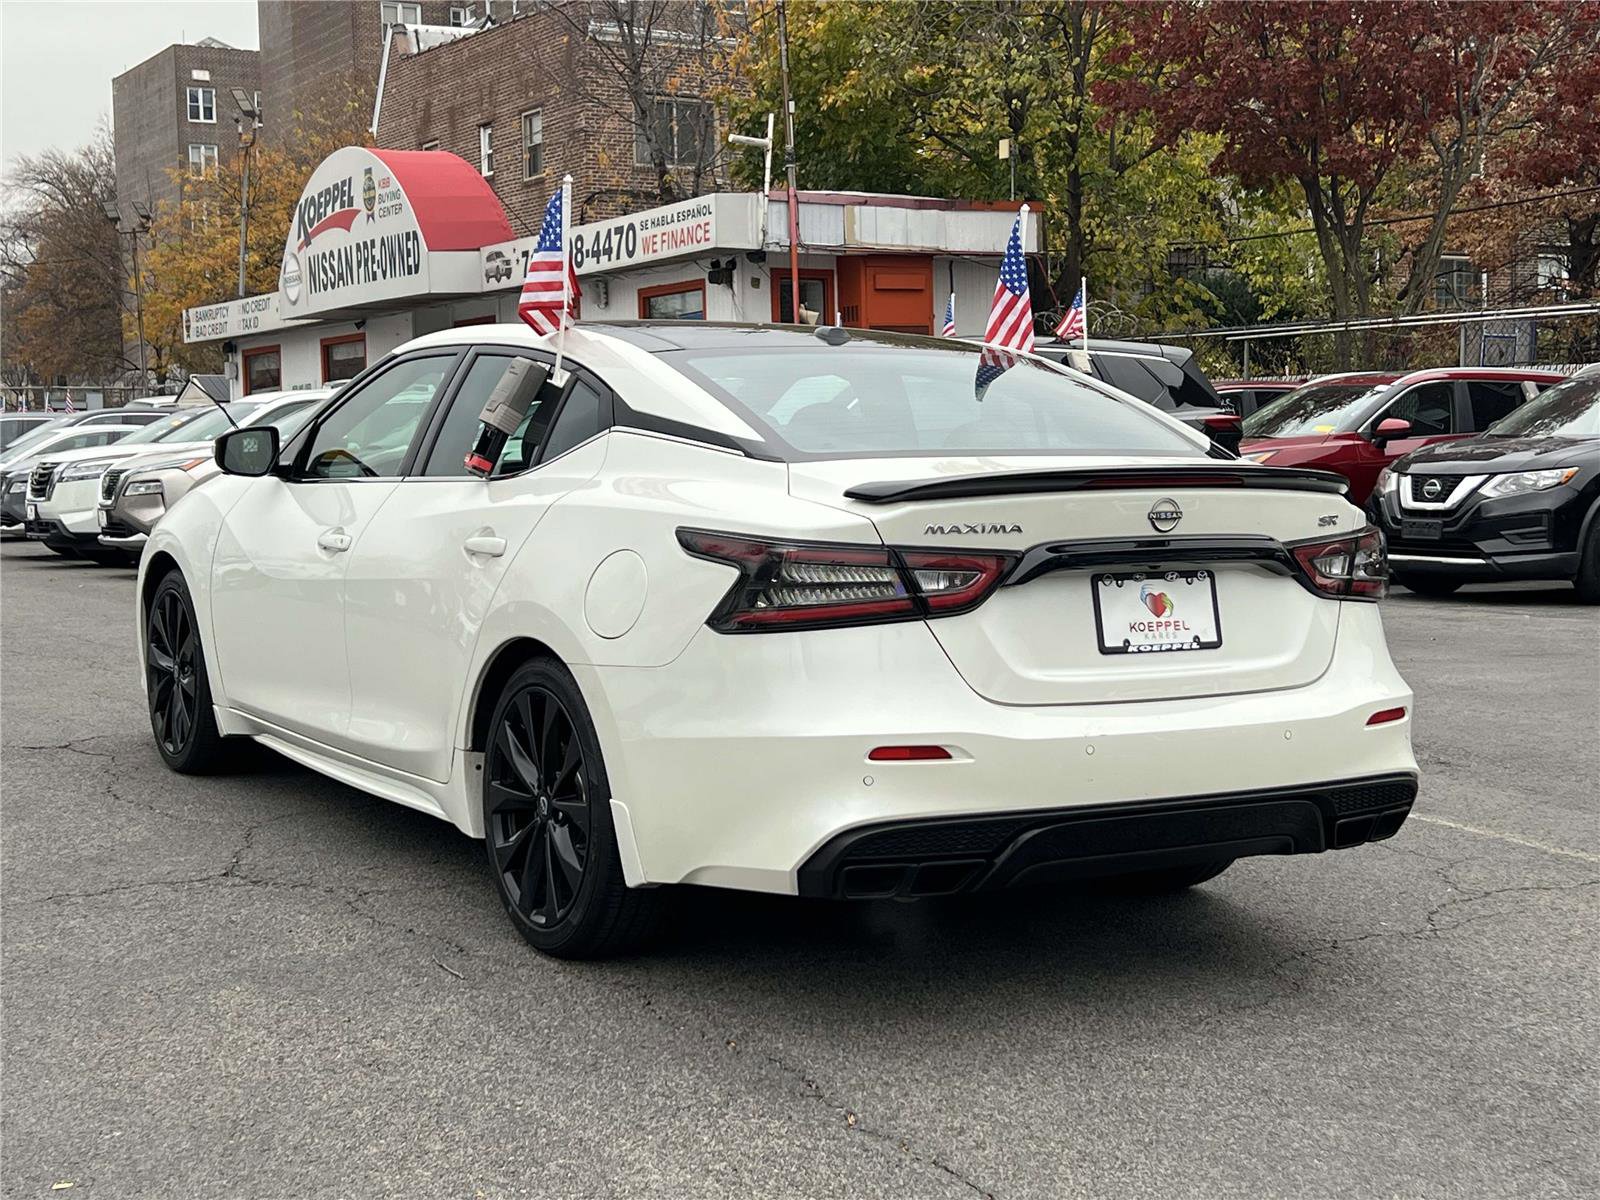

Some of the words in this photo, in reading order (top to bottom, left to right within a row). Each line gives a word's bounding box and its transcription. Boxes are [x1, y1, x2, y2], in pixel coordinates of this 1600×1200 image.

[378, 188, 401, 204] BUYING
[297, 176, 354, 249] KOEPPEL
[378, 202, 403, 218] CENTER
[640, 220, 649, 231] SE
[651, 214, 674, 229] HABLA
[676, 203, 712, 223] ESPAÑOL
[641, 234, 658, 255] WE
[661, 222, 710, 251] FINANCE
[308, 244, 354, 295] NISSAN
[355, 230, 420, 285] PRE-OWNED
[195, 306, 229, 322] BANKRUPTCY
[242, 302, 250, 314] NO
[251, 298, 270, 312] CREDIT
[196, 325, 207, 337] BAD
[208, 322, 228, 336] CREDIT
[242, 317, 252, 330] TAX
[923, 523, 1023, 535] MAXIMA
[1318, 515, 1339, 527] SR
[1129, 620, 1190, 633] KOEPPEL
[1127, 641, 1200, 653] KOEPPEL
